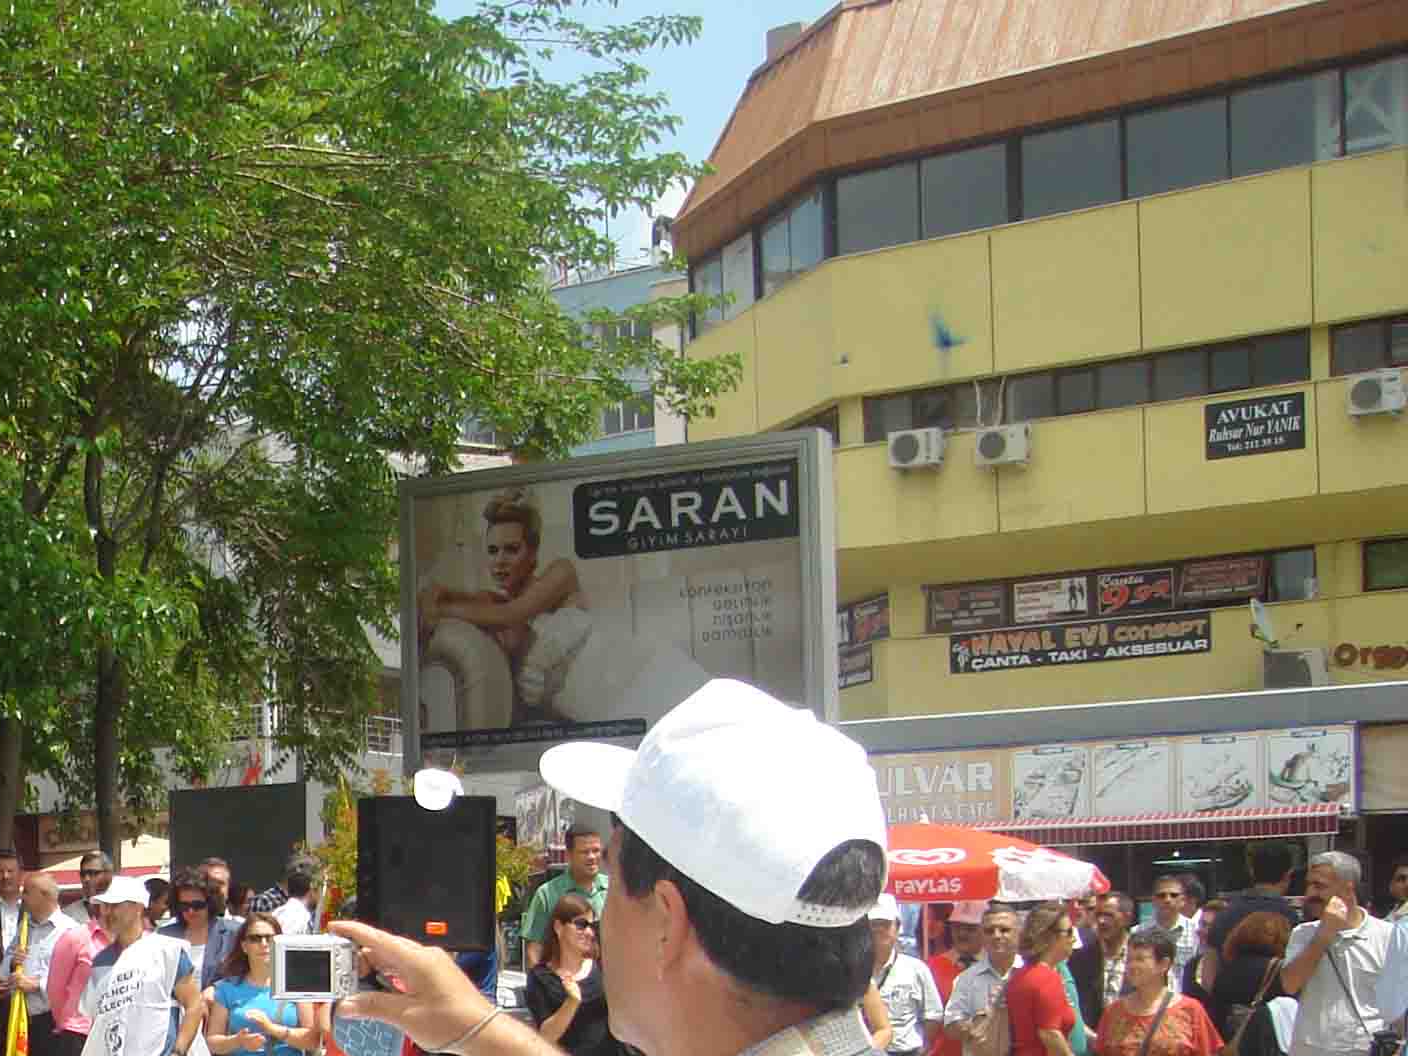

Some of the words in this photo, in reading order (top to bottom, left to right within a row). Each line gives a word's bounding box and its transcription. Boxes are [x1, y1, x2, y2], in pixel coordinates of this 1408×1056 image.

[1217, 400, 1294, 424] AVUKAT
[588, 479, 790, 536] SARAN
[1104, 639, 1209, 658] AKSESUAR
